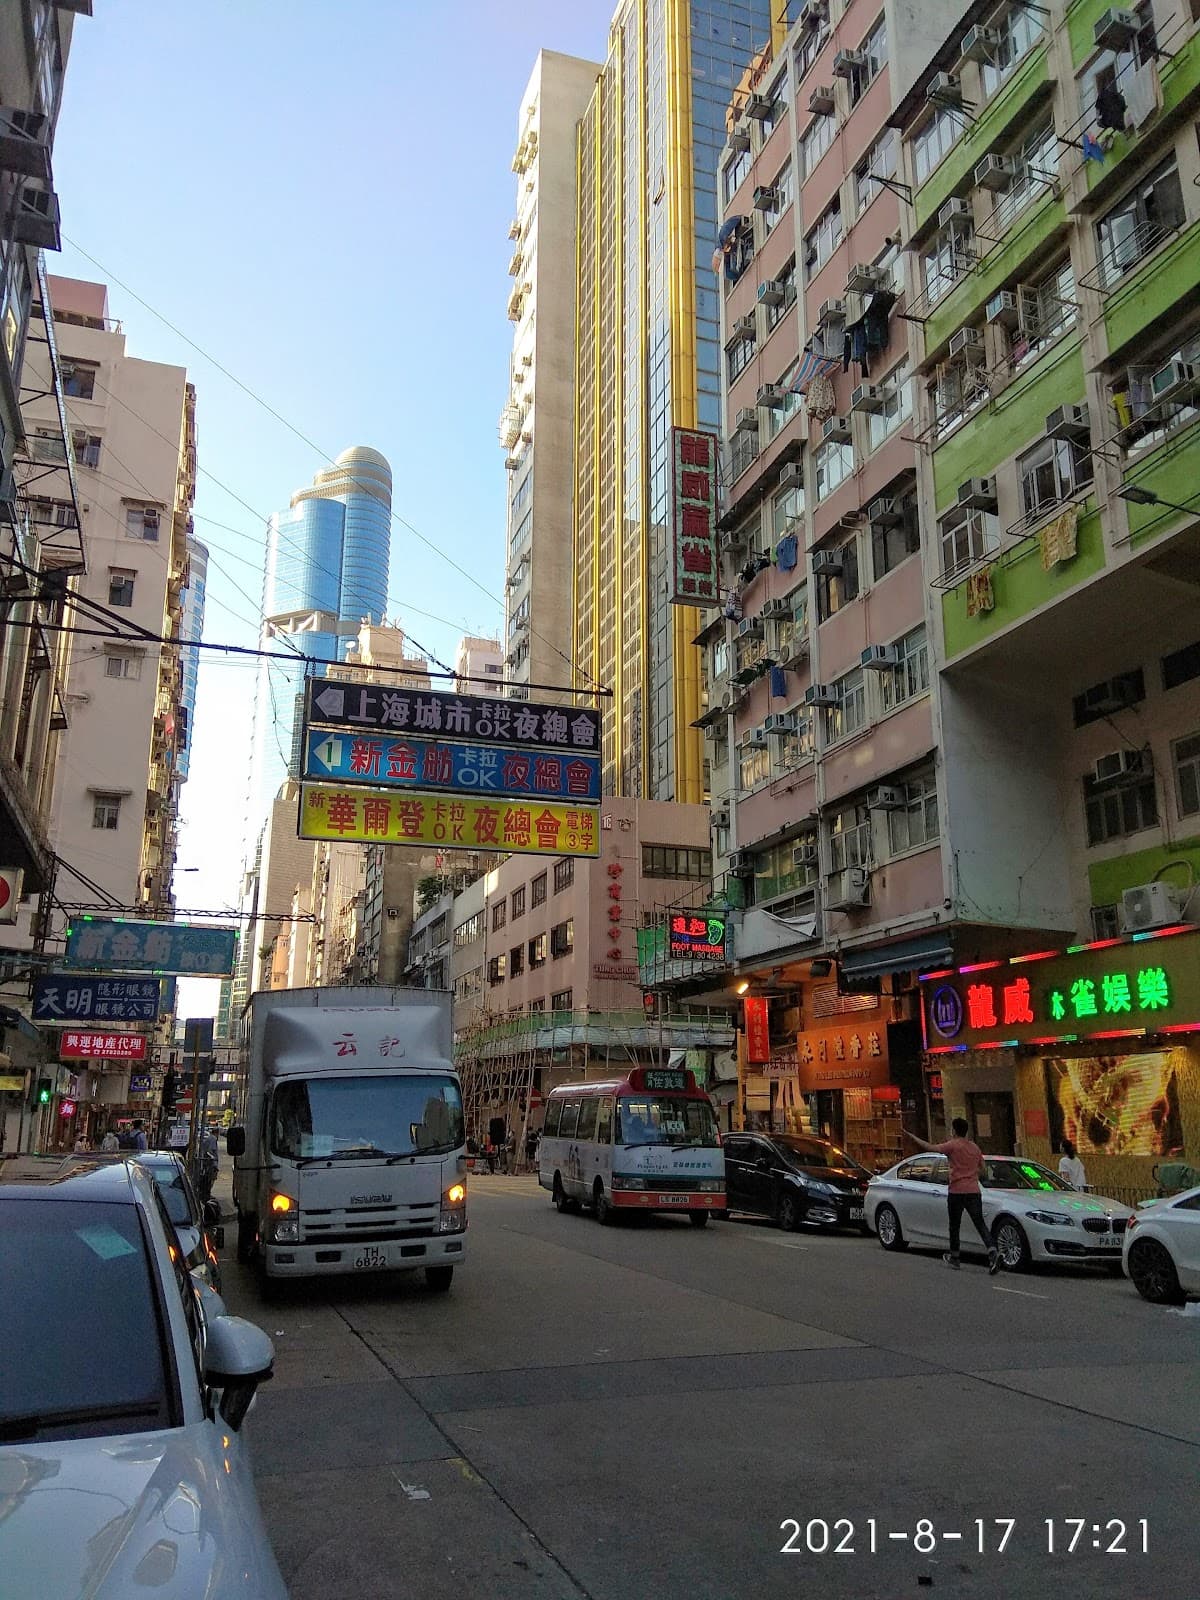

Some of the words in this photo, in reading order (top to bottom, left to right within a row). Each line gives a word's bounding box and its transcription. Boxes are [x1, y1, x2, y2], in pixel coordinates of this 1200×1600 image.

[347, 689, 473, 733] 上海城市
[513, 707, 597, 746] 夜總會
[457, 767, 498, 788] OK
[502, 752, 593, 797] 夜總會
[473, 805, 562, 849] 夜總會
[671, 942, 691, 951] FOOT
[36, 987, 93, 1015] 天明
[95, 1002, 155, 1017] 眼鏡公司
[968, 978, 1034, 1029] 龍威
[350, 1194, 393, 1204] ISUZU
[355, 1256, 386, 1267] 6822
[363, 1247, 379, 1257] TH
